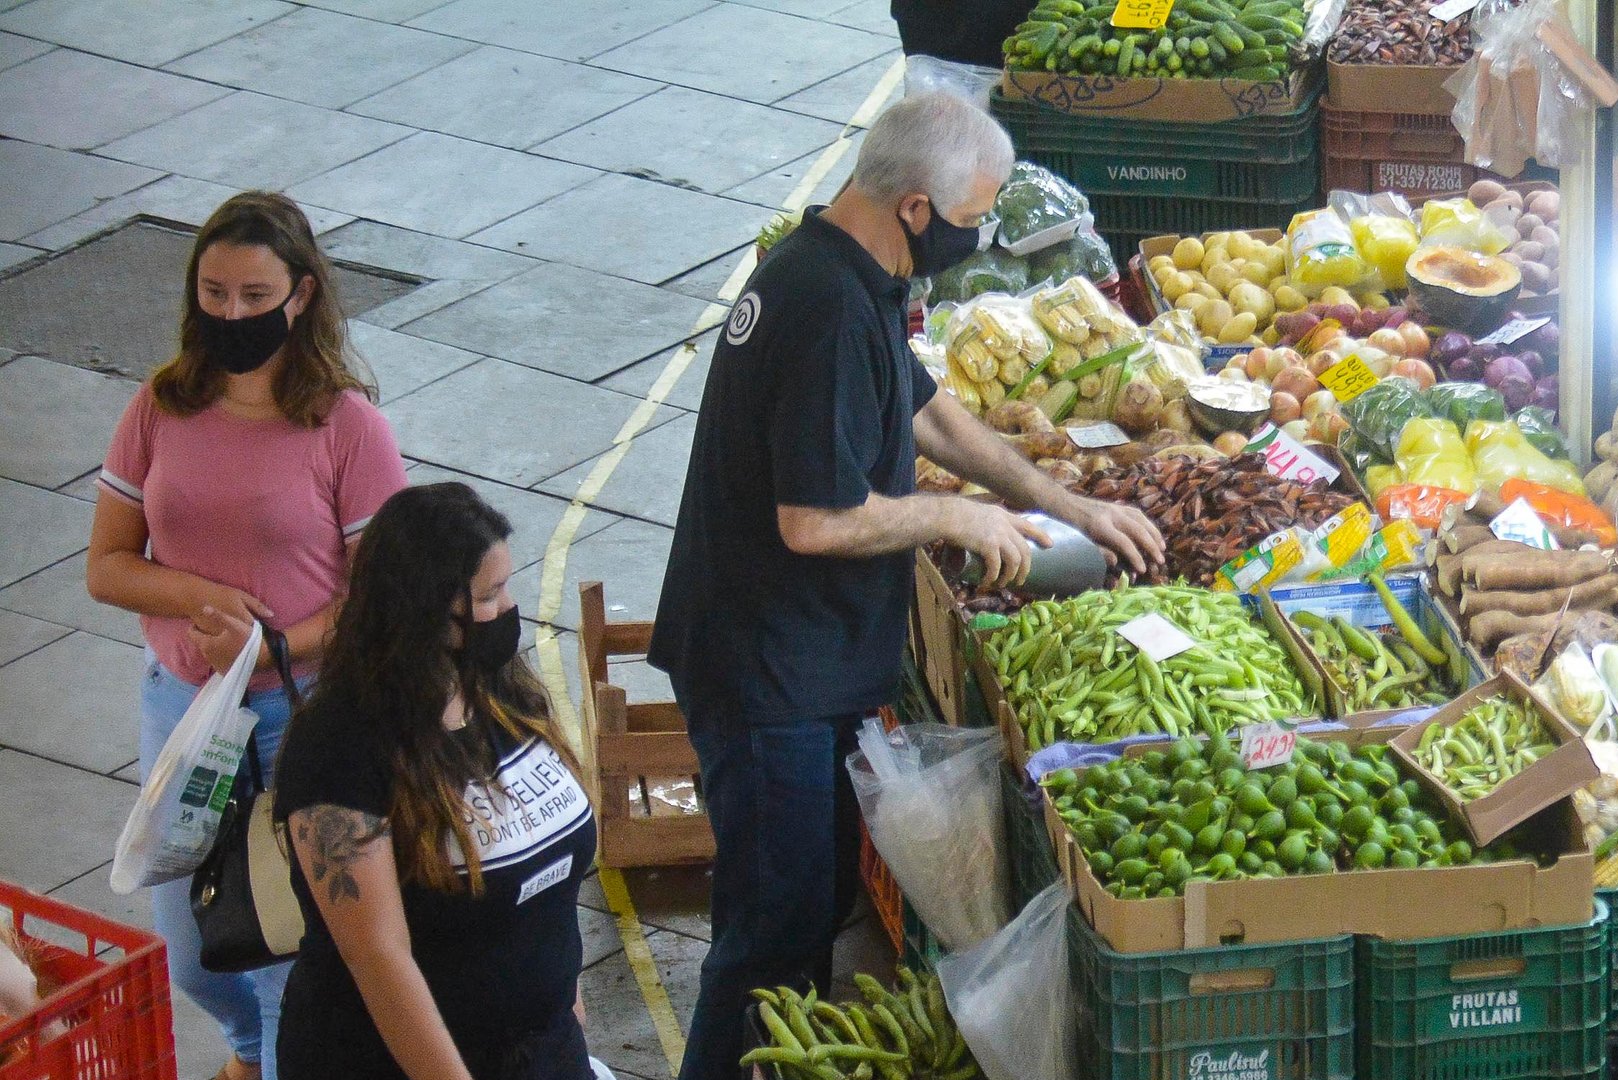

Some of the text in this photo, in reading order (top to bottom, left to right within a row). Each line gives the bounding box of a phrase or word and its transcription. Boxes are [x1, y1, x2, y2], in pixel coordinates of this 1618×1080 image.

[1107, 166, 1187, 180] VANDINHO
[1380, 163, 1462, 179] FRUTAS ROHR
[733, 308, 748, 330] 10
[519, 811, 542, 834] BE
[539, 785, 578, 823] AFRAID
[537, 862, 570, 893] BRAVE
[1452, 990, 1519, 1010] FRUTAS
[1449, 1007, 1522, 1028] VILLANI
[1189, 1049, 1269, 1076] Paulisul
